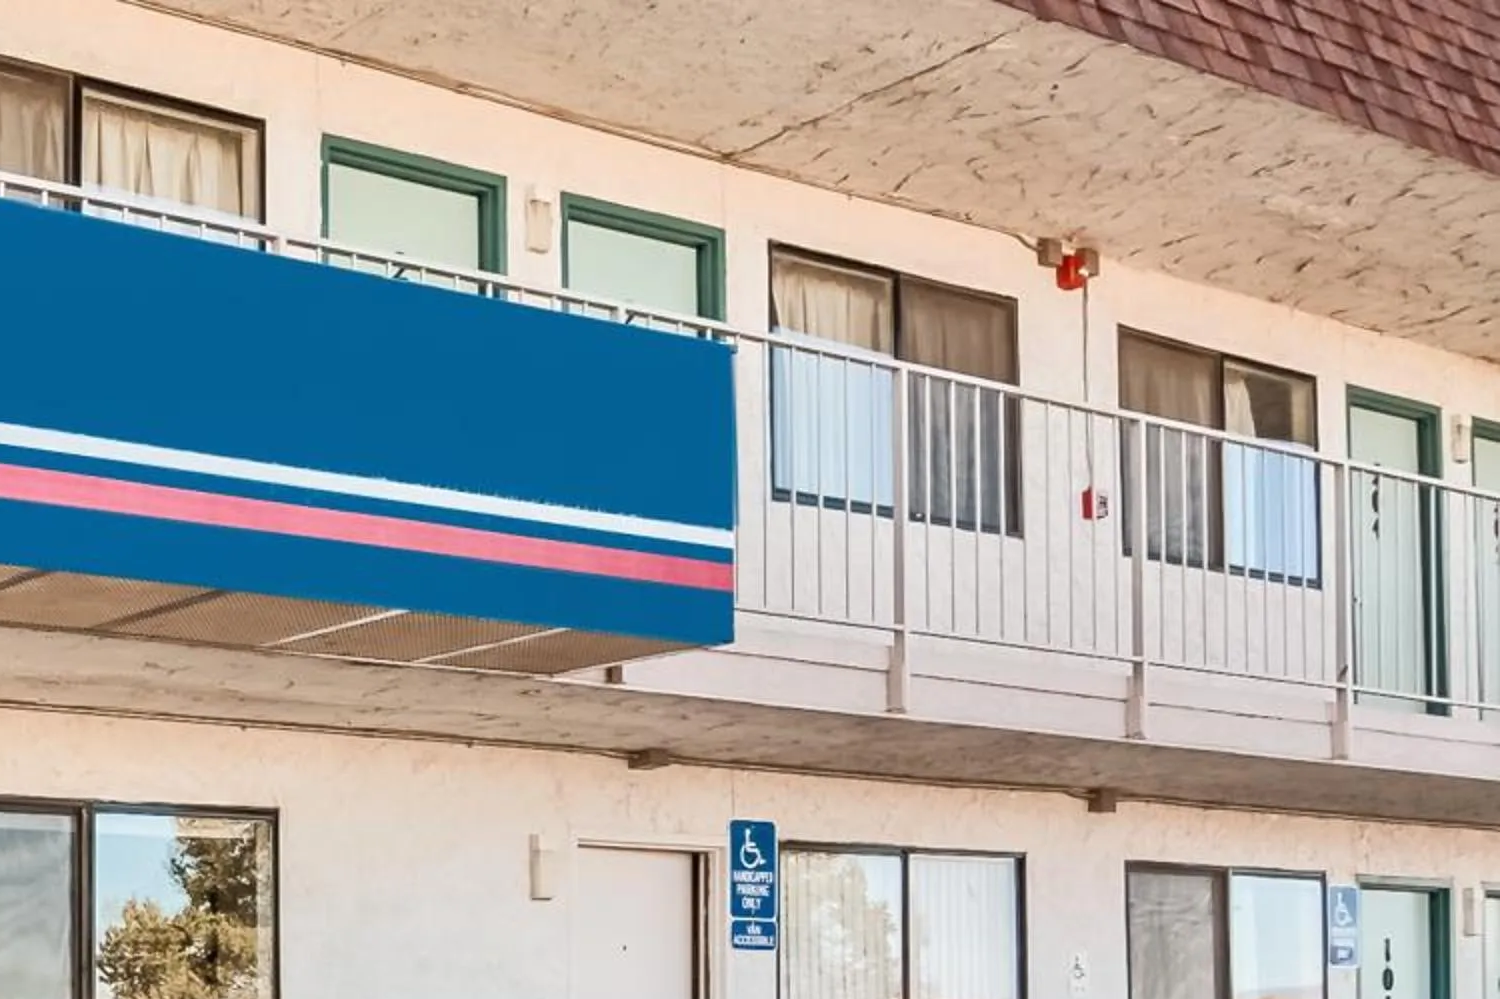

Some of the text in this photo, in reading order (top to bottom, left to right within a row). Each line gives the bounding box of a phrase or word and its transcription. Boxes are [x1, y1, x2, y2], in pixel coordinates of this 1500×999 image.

[733, 870, 773, 883] HANDICAPPED
[736, 884, 770, 896] PARKING
[742, 896, 762, 909] ONLY
